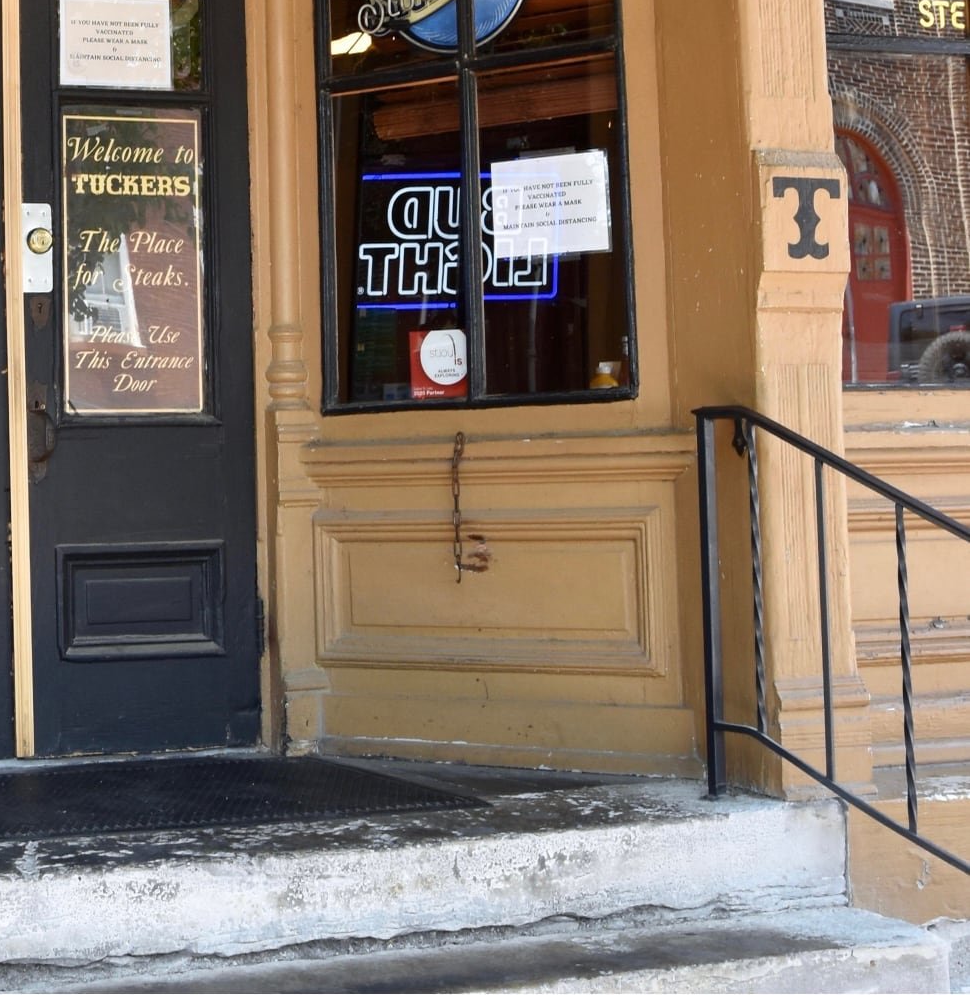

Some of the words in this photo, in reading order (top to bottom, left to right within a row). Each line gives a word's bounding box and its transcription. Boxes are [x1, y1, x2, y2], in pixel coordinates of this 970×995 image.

[67, 136, 164, 164] Welcome
[174, 145, 194, 165] to
[527, 191, 567, 200] VACCINATED
[515, 203, 538, 211] PEASE
[536, 220, 557, 228] SOCIAL
[558, 216, 597, 226] DISTANCING
[772, 177, 840, 260] T
[80, 227, 121, 253] The
[130, 231, 184, 253] Place
[73, 263, 103, 290] for
[112, 263, 189, 293] Steaks.
[87, 325, 140, 344] Please
[148, 325, 180, 344] Use
[74, 349, 112, 369] This
[120, 350, 194, 370] Entrance
[112, 373, 158, 393] Door
